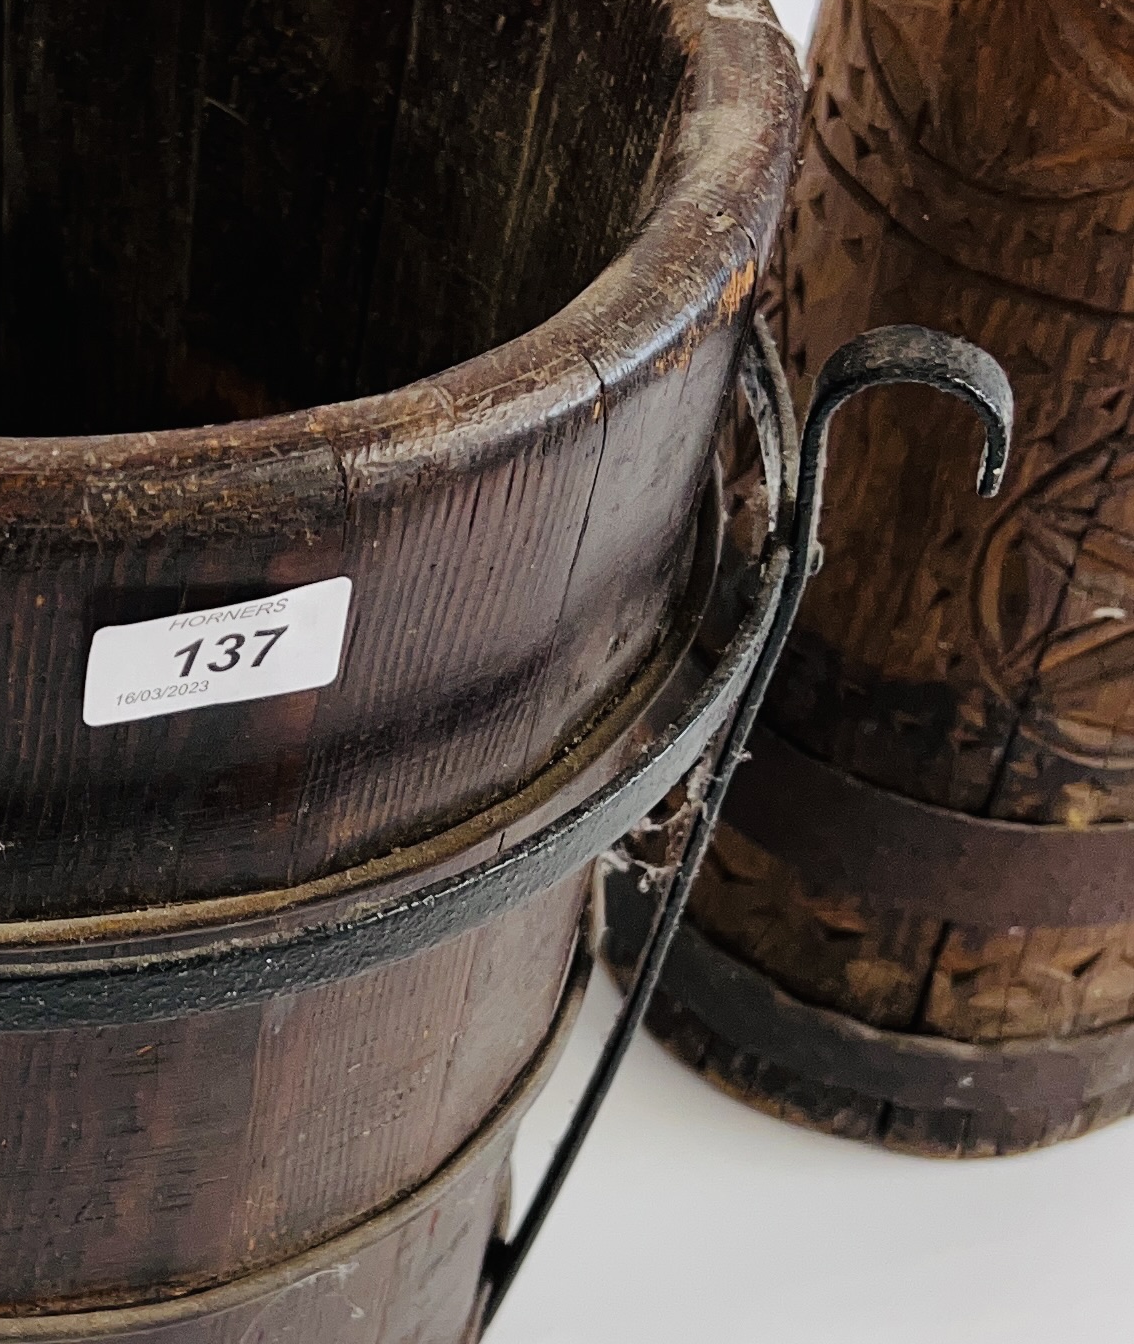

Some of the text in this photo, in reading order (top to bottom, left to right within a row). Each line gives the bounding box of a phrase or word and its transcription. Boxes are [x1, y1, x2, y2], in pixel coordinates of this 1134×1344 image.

[168, 597, 289, 632] HORNERS
[173, 624, 289, 678] 137
[116, 680, 210, 706] 16/03/2023
